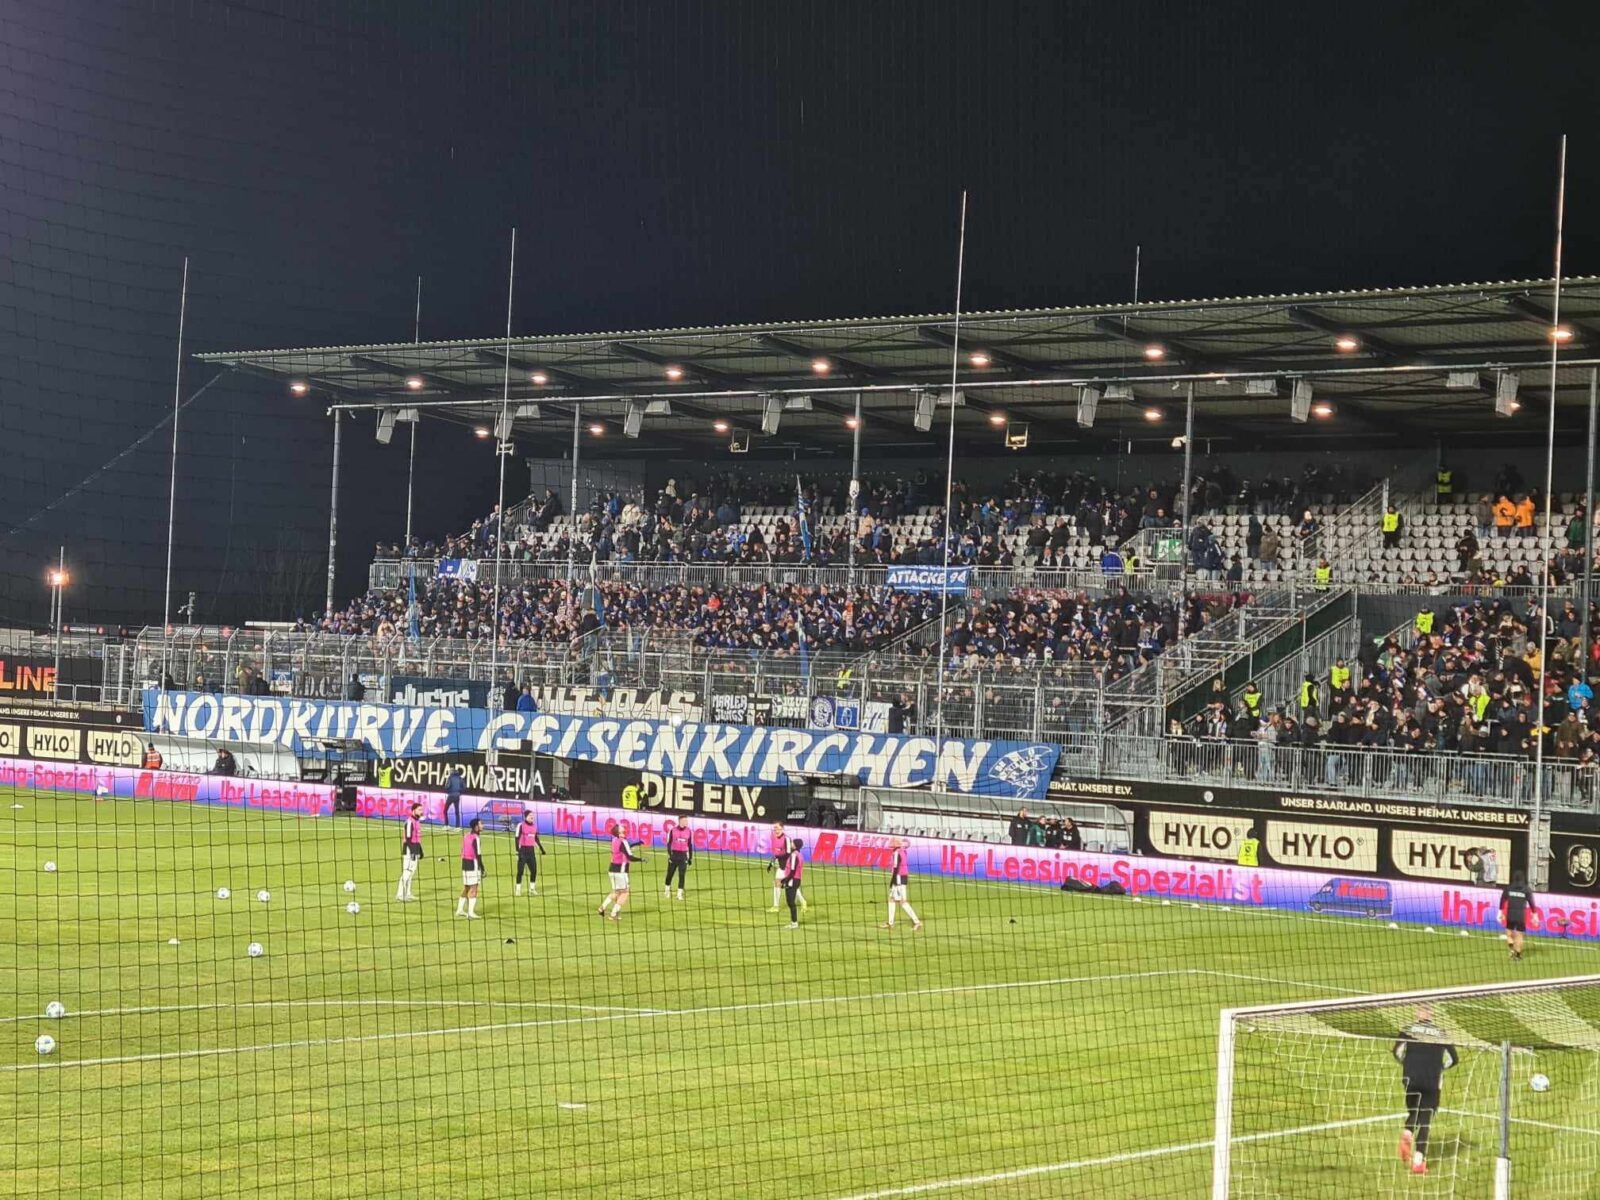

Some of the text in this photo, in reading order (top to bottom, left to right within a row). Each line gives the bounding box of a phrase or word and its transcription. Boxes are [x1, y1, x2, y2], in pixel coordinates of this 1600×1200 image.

[34, 734, 69, 753] HYLO
[94, 738, 131, 757] HYLO
[220, 780, 245, 802] Ihr
[640, 771, 766, 821] DIE ELV.
[1078, 783, 1113, 794] UNSERE
[1114, 785, 1133, 795] ELV.
[556, 808, 585, 832] Ihr
[1281, 797, 1314, 808] UNSER
[1315, 800, 1374, 813] SAARLAND.
[1375, 804, 1416, 816] UNSERE
[1461, 811, 1505, 823] UNSERE
[1506, 814, 1529, 824] ELV.
[1164, 822, 1233, 850] HYLO
[1281, 831, 1355, 861] HYLO
[941, 845, 976, 872] Ihr
[1442, 890, 1490, 924] Ihr
